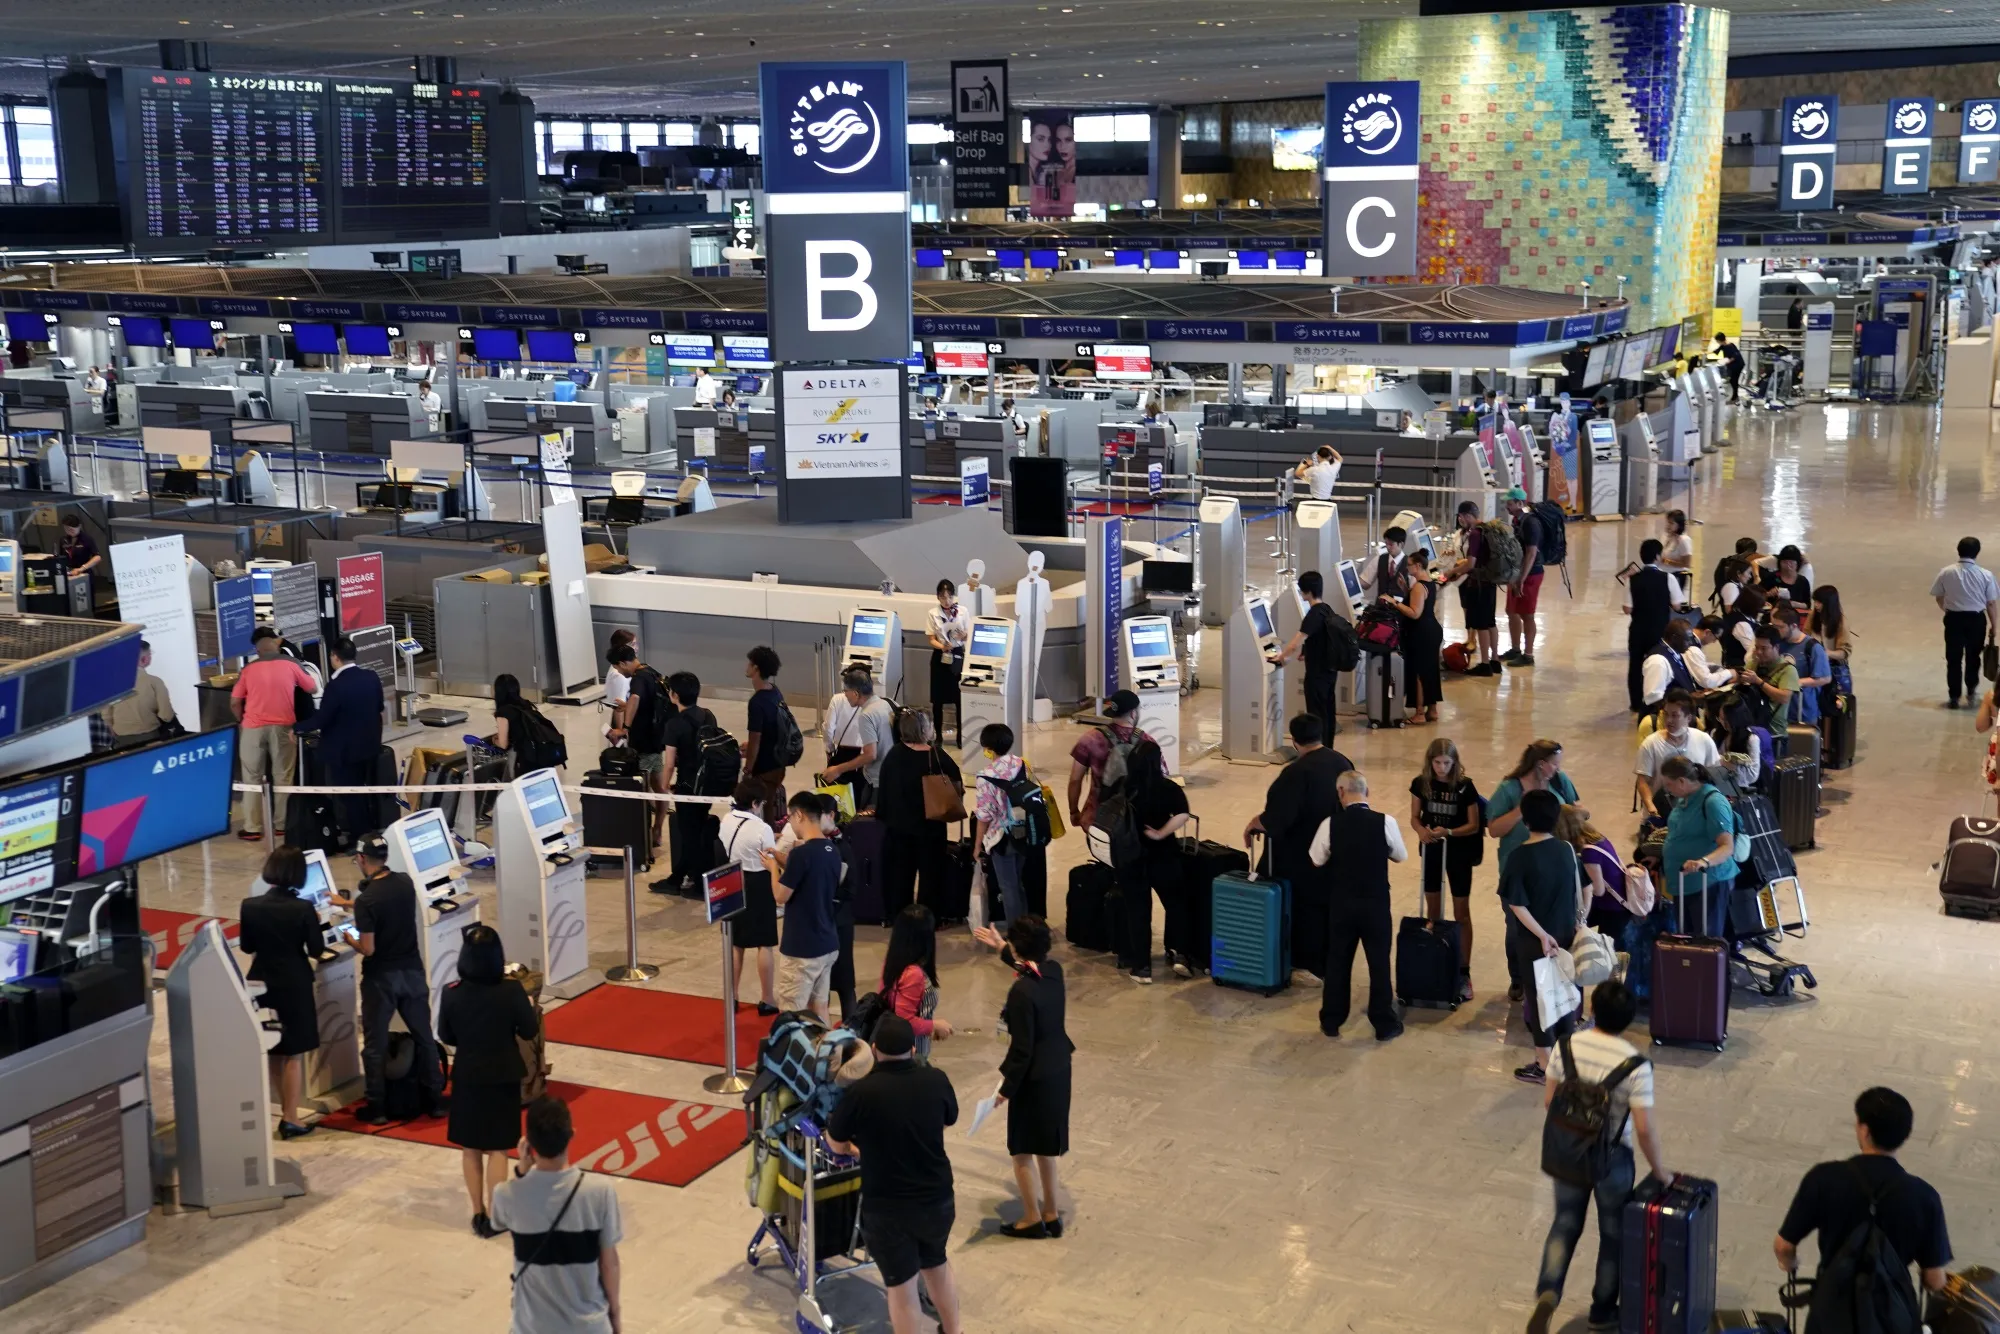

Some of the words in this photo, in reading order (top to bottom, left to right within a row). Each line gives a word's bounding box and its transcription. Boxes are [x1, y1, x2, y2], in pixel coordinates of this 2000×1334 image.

[222, 77, 323, 93] 北ウイング出発便ご案内
[336, 84, 351, 92] North
[351, 85, 365, 94] Wing
[365, 85, 393, 94] Departures
[790, 81, 862, 156] SKYTEAM
[956, 130, 978, 143] Self
[981, 131, 1004, 145] Bag
[956, 147, 986, 160] Drop
[1968, 147, 1991, 175] F
[1894, 153, 1920, 185] E
[1791, 162, 1824, 200] D
[1346, 196, 1396, 258] C
[805, 240, 878, 331] B
[223, 304, 257, 312] SKYTEAM
[316, 307, 351, 315] SKYTEAM
[410, 310, 447, 318] SKYTEAM
[508, 313, 546, 321] SKYTEAM
[609, 315, 648, 324] SKYTEAM
[715, 318, 755, 326] SKYTEAM
[938, 323, 981, 331] SKYTEAM
[1056, 325, 1101, 333] SKYTEAM
[1181, 327, 1228, 336] SKYTEAM
[1312, 329, 1361, 338] SKYTEAM
[1437, 331, 1490, 339] SKYTEAM
[1293, 346, 1357, 356] 発券カウンター
[818, 379, 867, 389] DELTA
[813, 409, 838, 418] ROYAL
[840, 408, 872, 417] BRUNEI
[816, 433, 848, 444] SKY
[813, 460, 847, 469] Vietnam
[847, 459, 879, 469] Airlines
[154, 542, 175, 550] DELTA
[116, 565, 162, 580] TRAVELING
[165, 563, 177, 573] TO
[340, 572, 375, 586] BAGGAGE
[118, 580, 134, 591] THE
[168, 746, 214, 769] DELTA
[63, 775, 75, 793] F
[61, 798, 72, 815] D
[7, 857, 21, 868] Self
[21, 855, 35, 864] Bag
[35, 849, 53, 860] Drop
